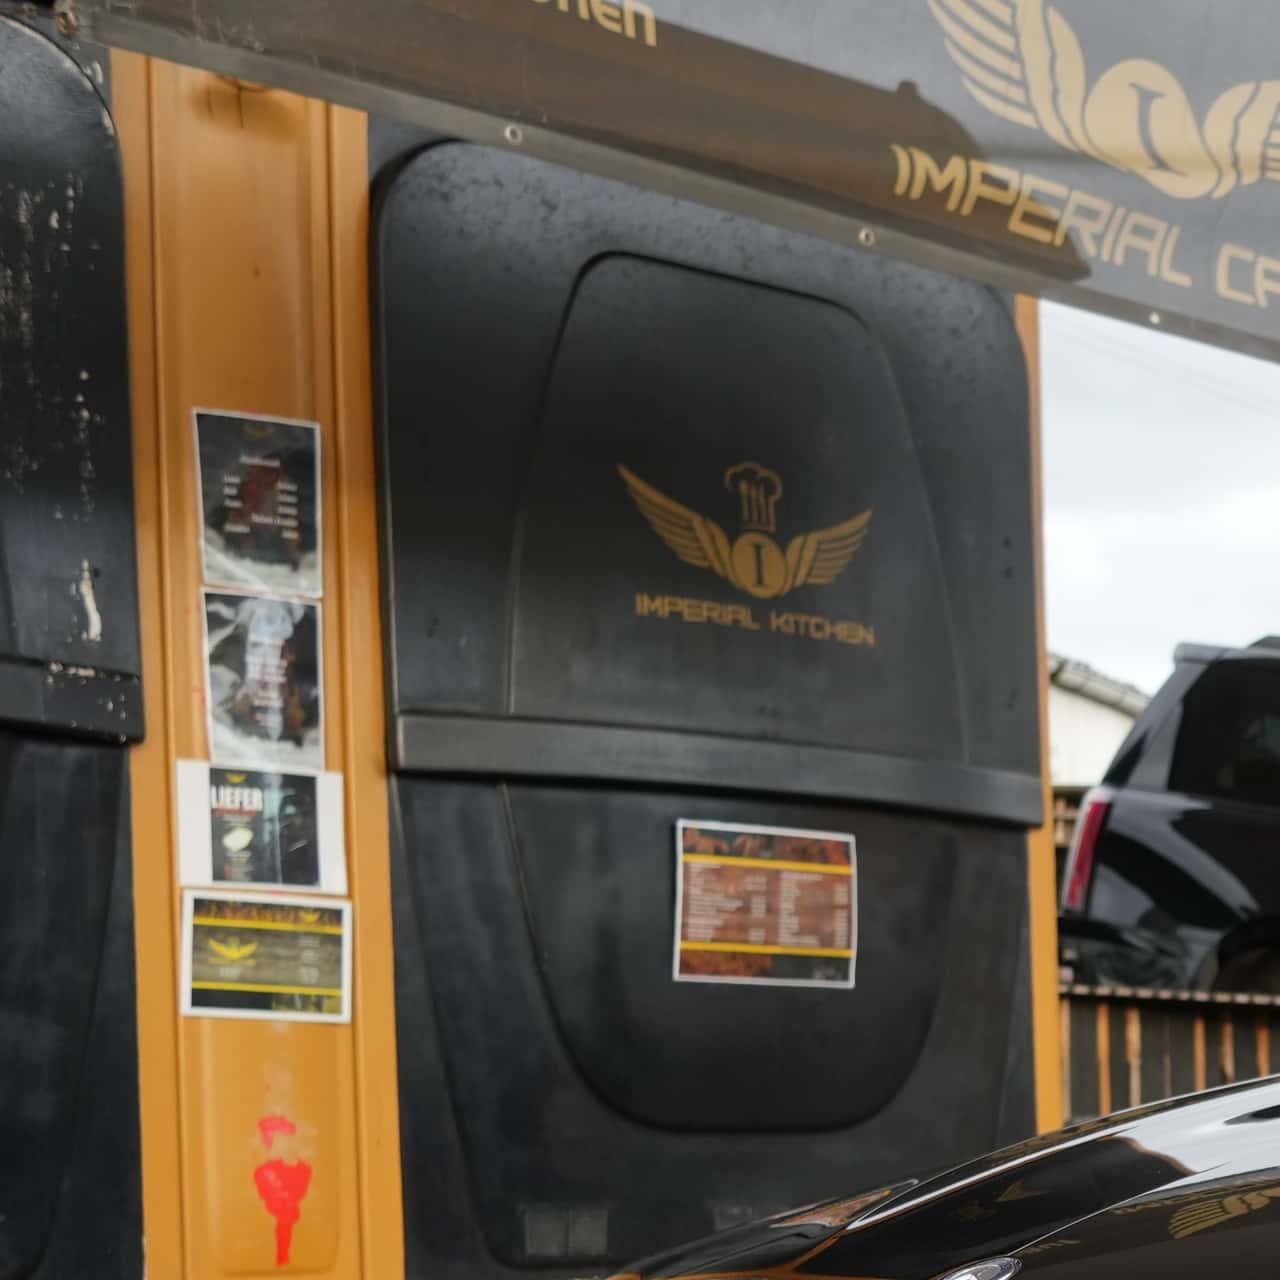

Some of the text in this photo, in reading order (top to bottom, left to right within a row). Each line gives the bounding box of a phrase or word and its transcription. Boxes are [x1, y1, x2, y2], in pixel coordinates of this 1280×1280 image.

[889, 144, 1192, 287] IMPERIAL
[634, 592, 876, 647] IMPERIAL KITCHEN
